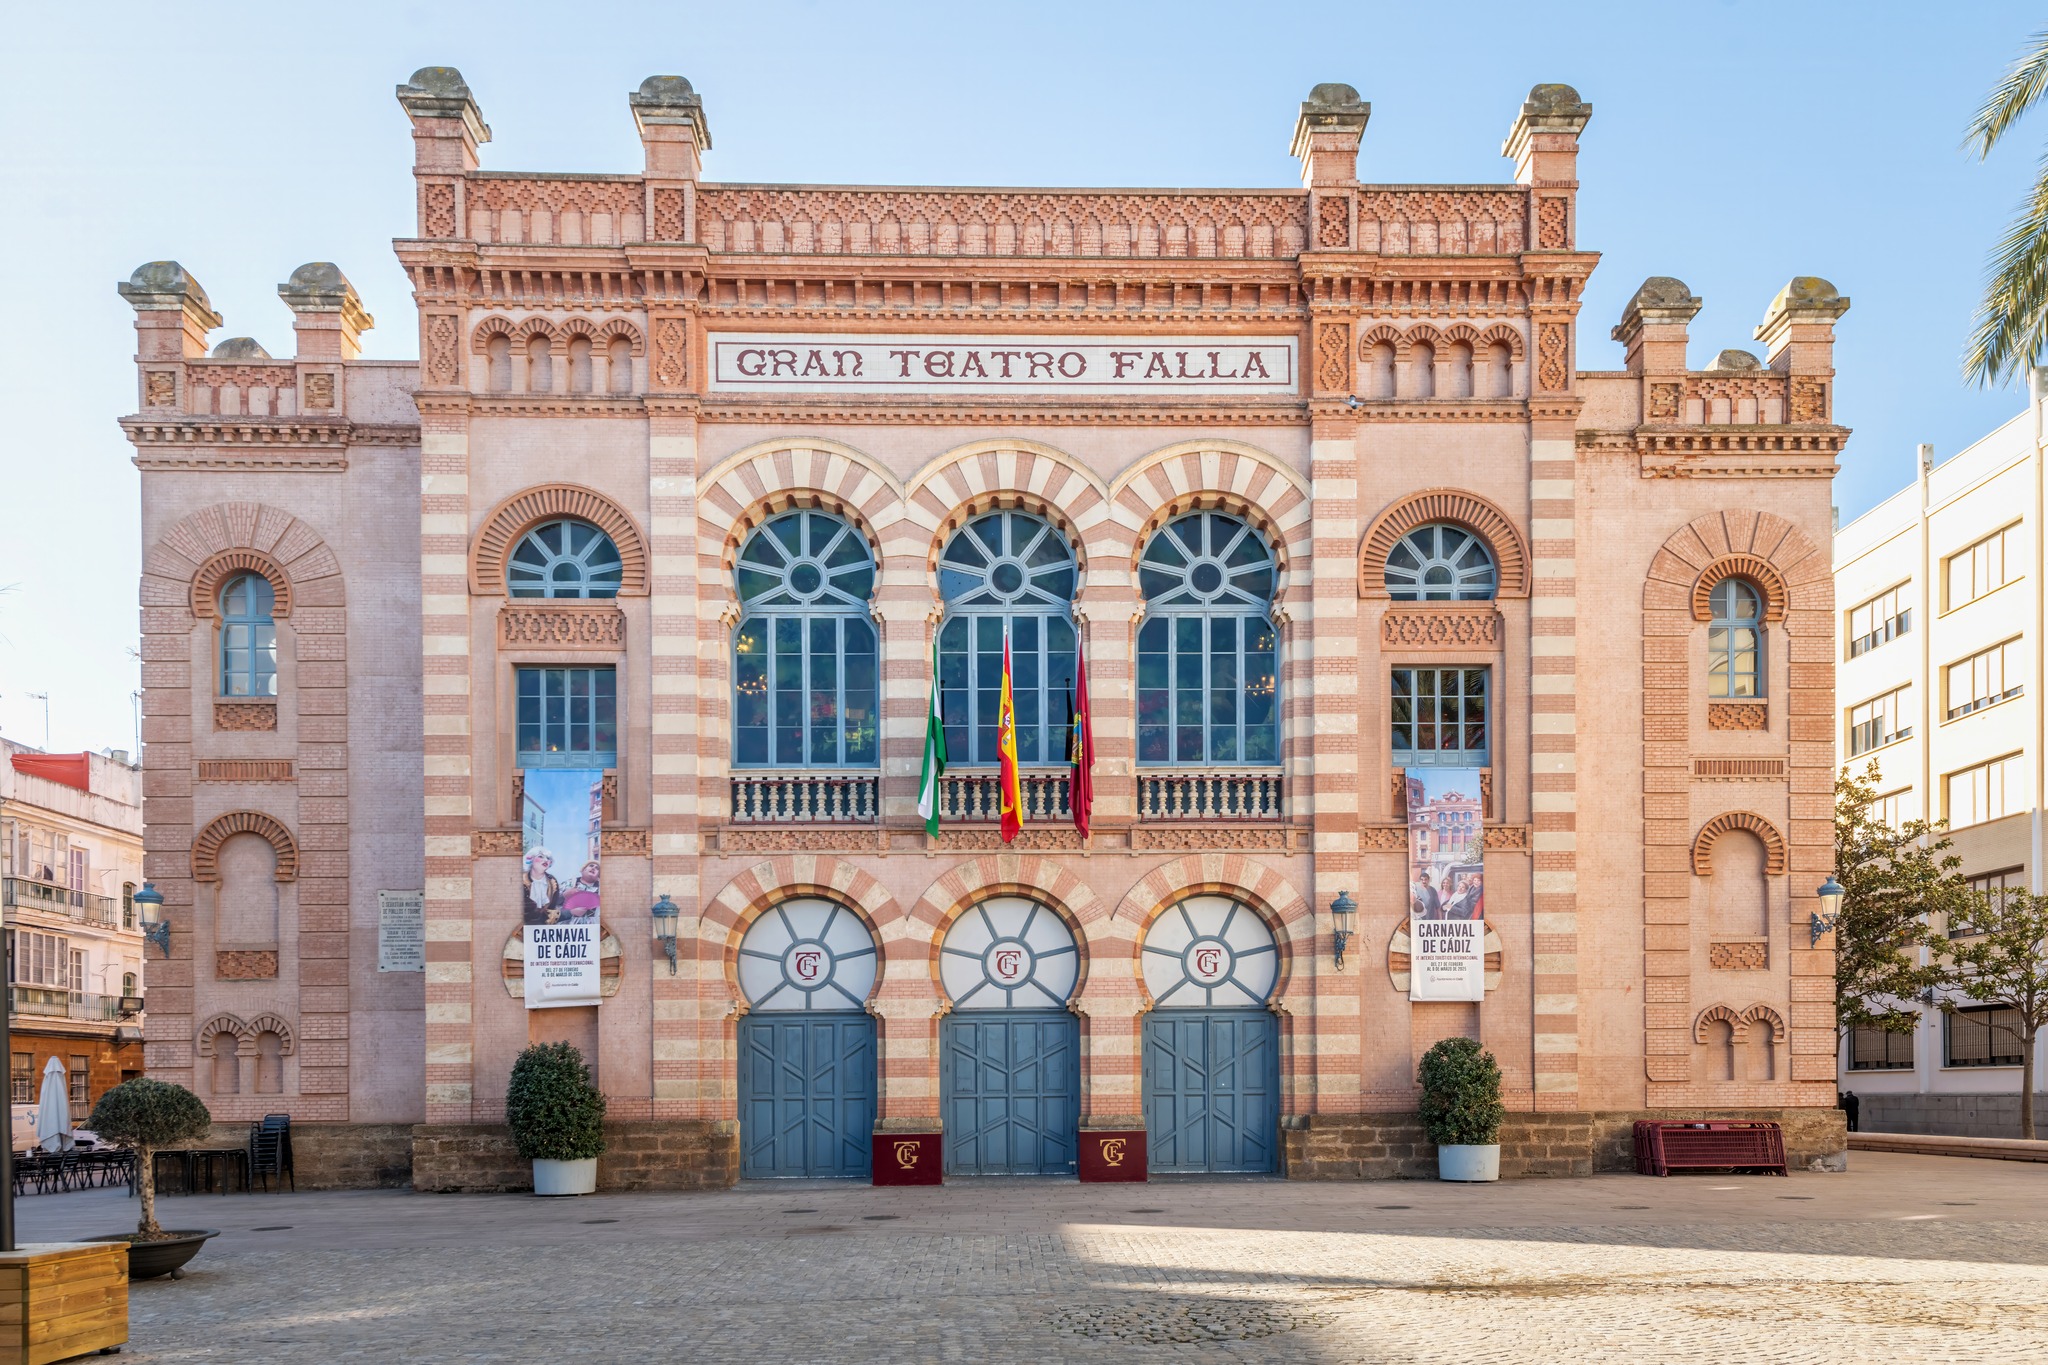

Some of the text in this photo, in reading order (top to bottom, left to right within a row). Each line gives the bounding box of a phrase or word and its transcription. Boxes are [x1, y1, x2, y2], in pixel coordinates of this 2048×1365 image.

[737, 349, 1271, 379] GRAN TEATRO FALLA
[534, 928, 591, 942] CARNAVAL
[1419, 924, 1474, 937] CARNAVAL
[538, 942, 587, 958] DE CÁDIZ
[1423, 938, 1471, 953] DE CÁDIZ
